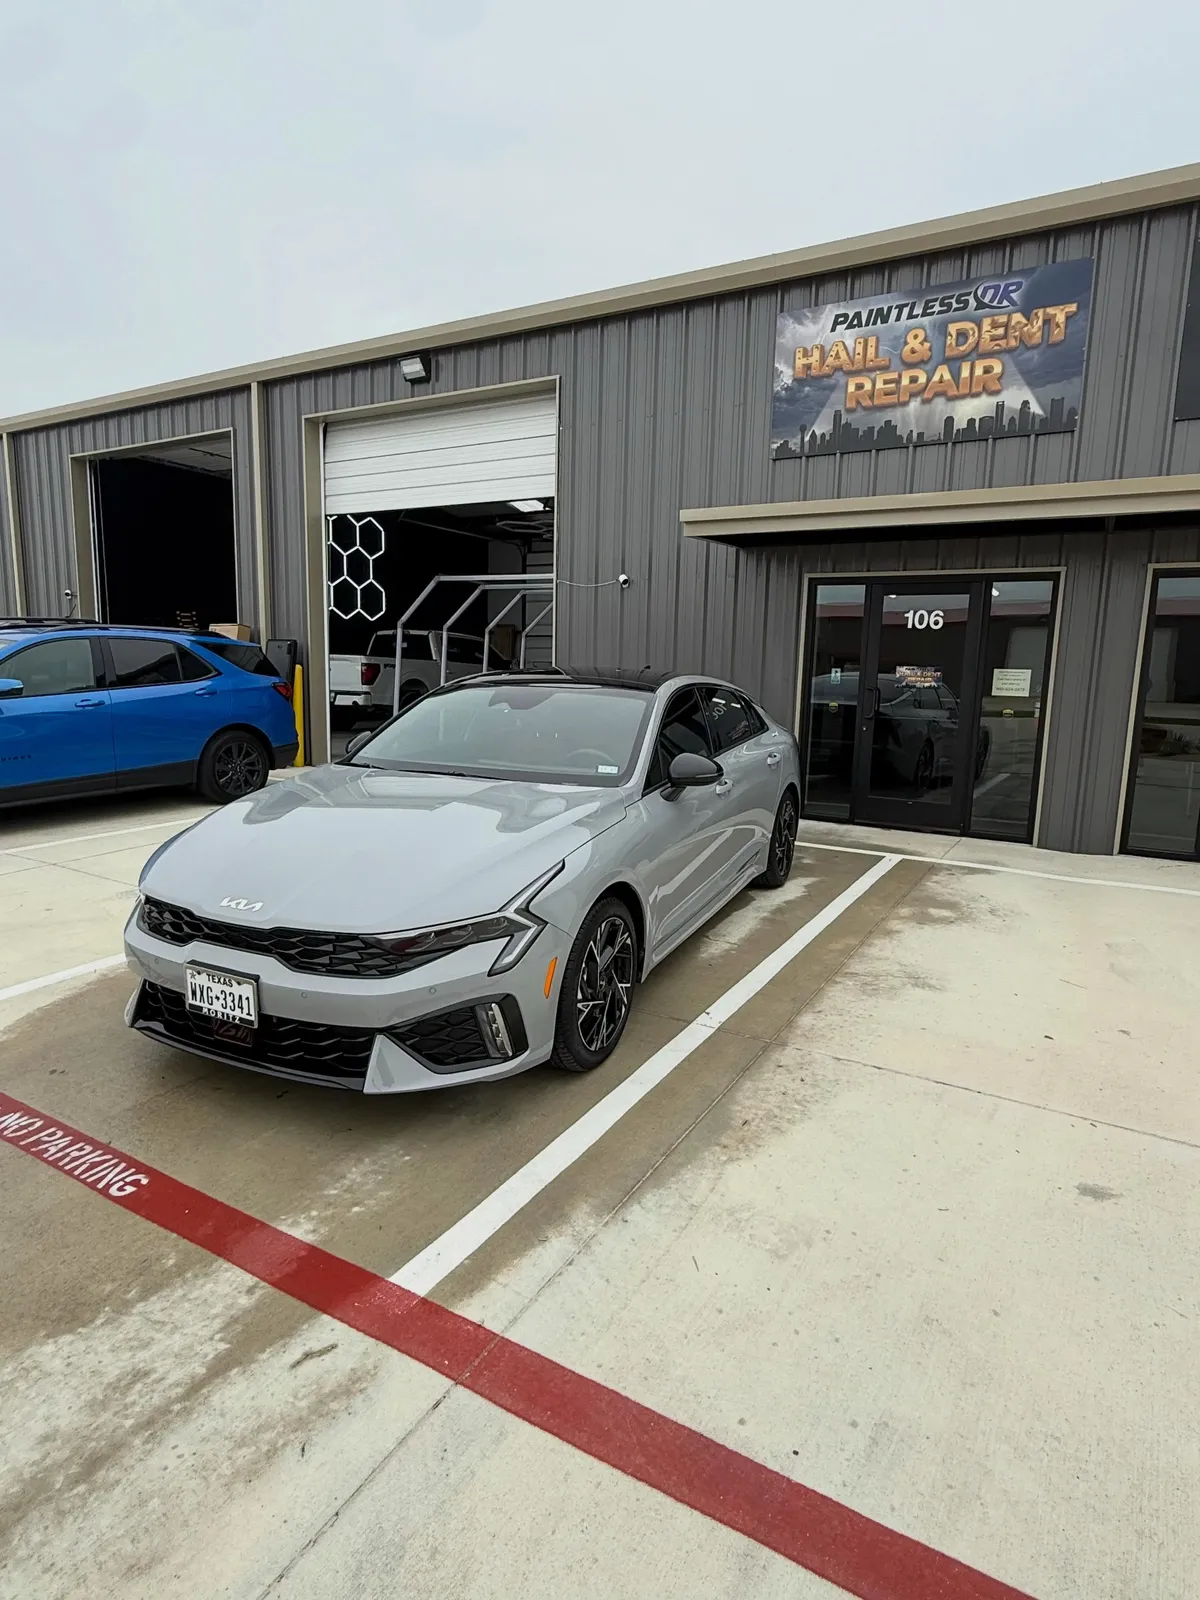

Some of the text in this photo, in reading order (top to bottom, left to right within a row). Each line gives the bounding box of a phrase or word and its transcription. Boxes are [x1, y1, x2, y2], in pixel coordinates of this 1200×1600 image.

[830, 291, 973, 333] PAINTLESS
[793, 302, 1078, 378] HAIL & DENT
[845, 358, 1003, 410] REPAIR
[904, 609, 945, 630] 106
[206, 973, 233, 987] TEXAS
[202, 1007, 241, 1023] MORITZ
[0, 1111, 150, 1197] NO PARKING
